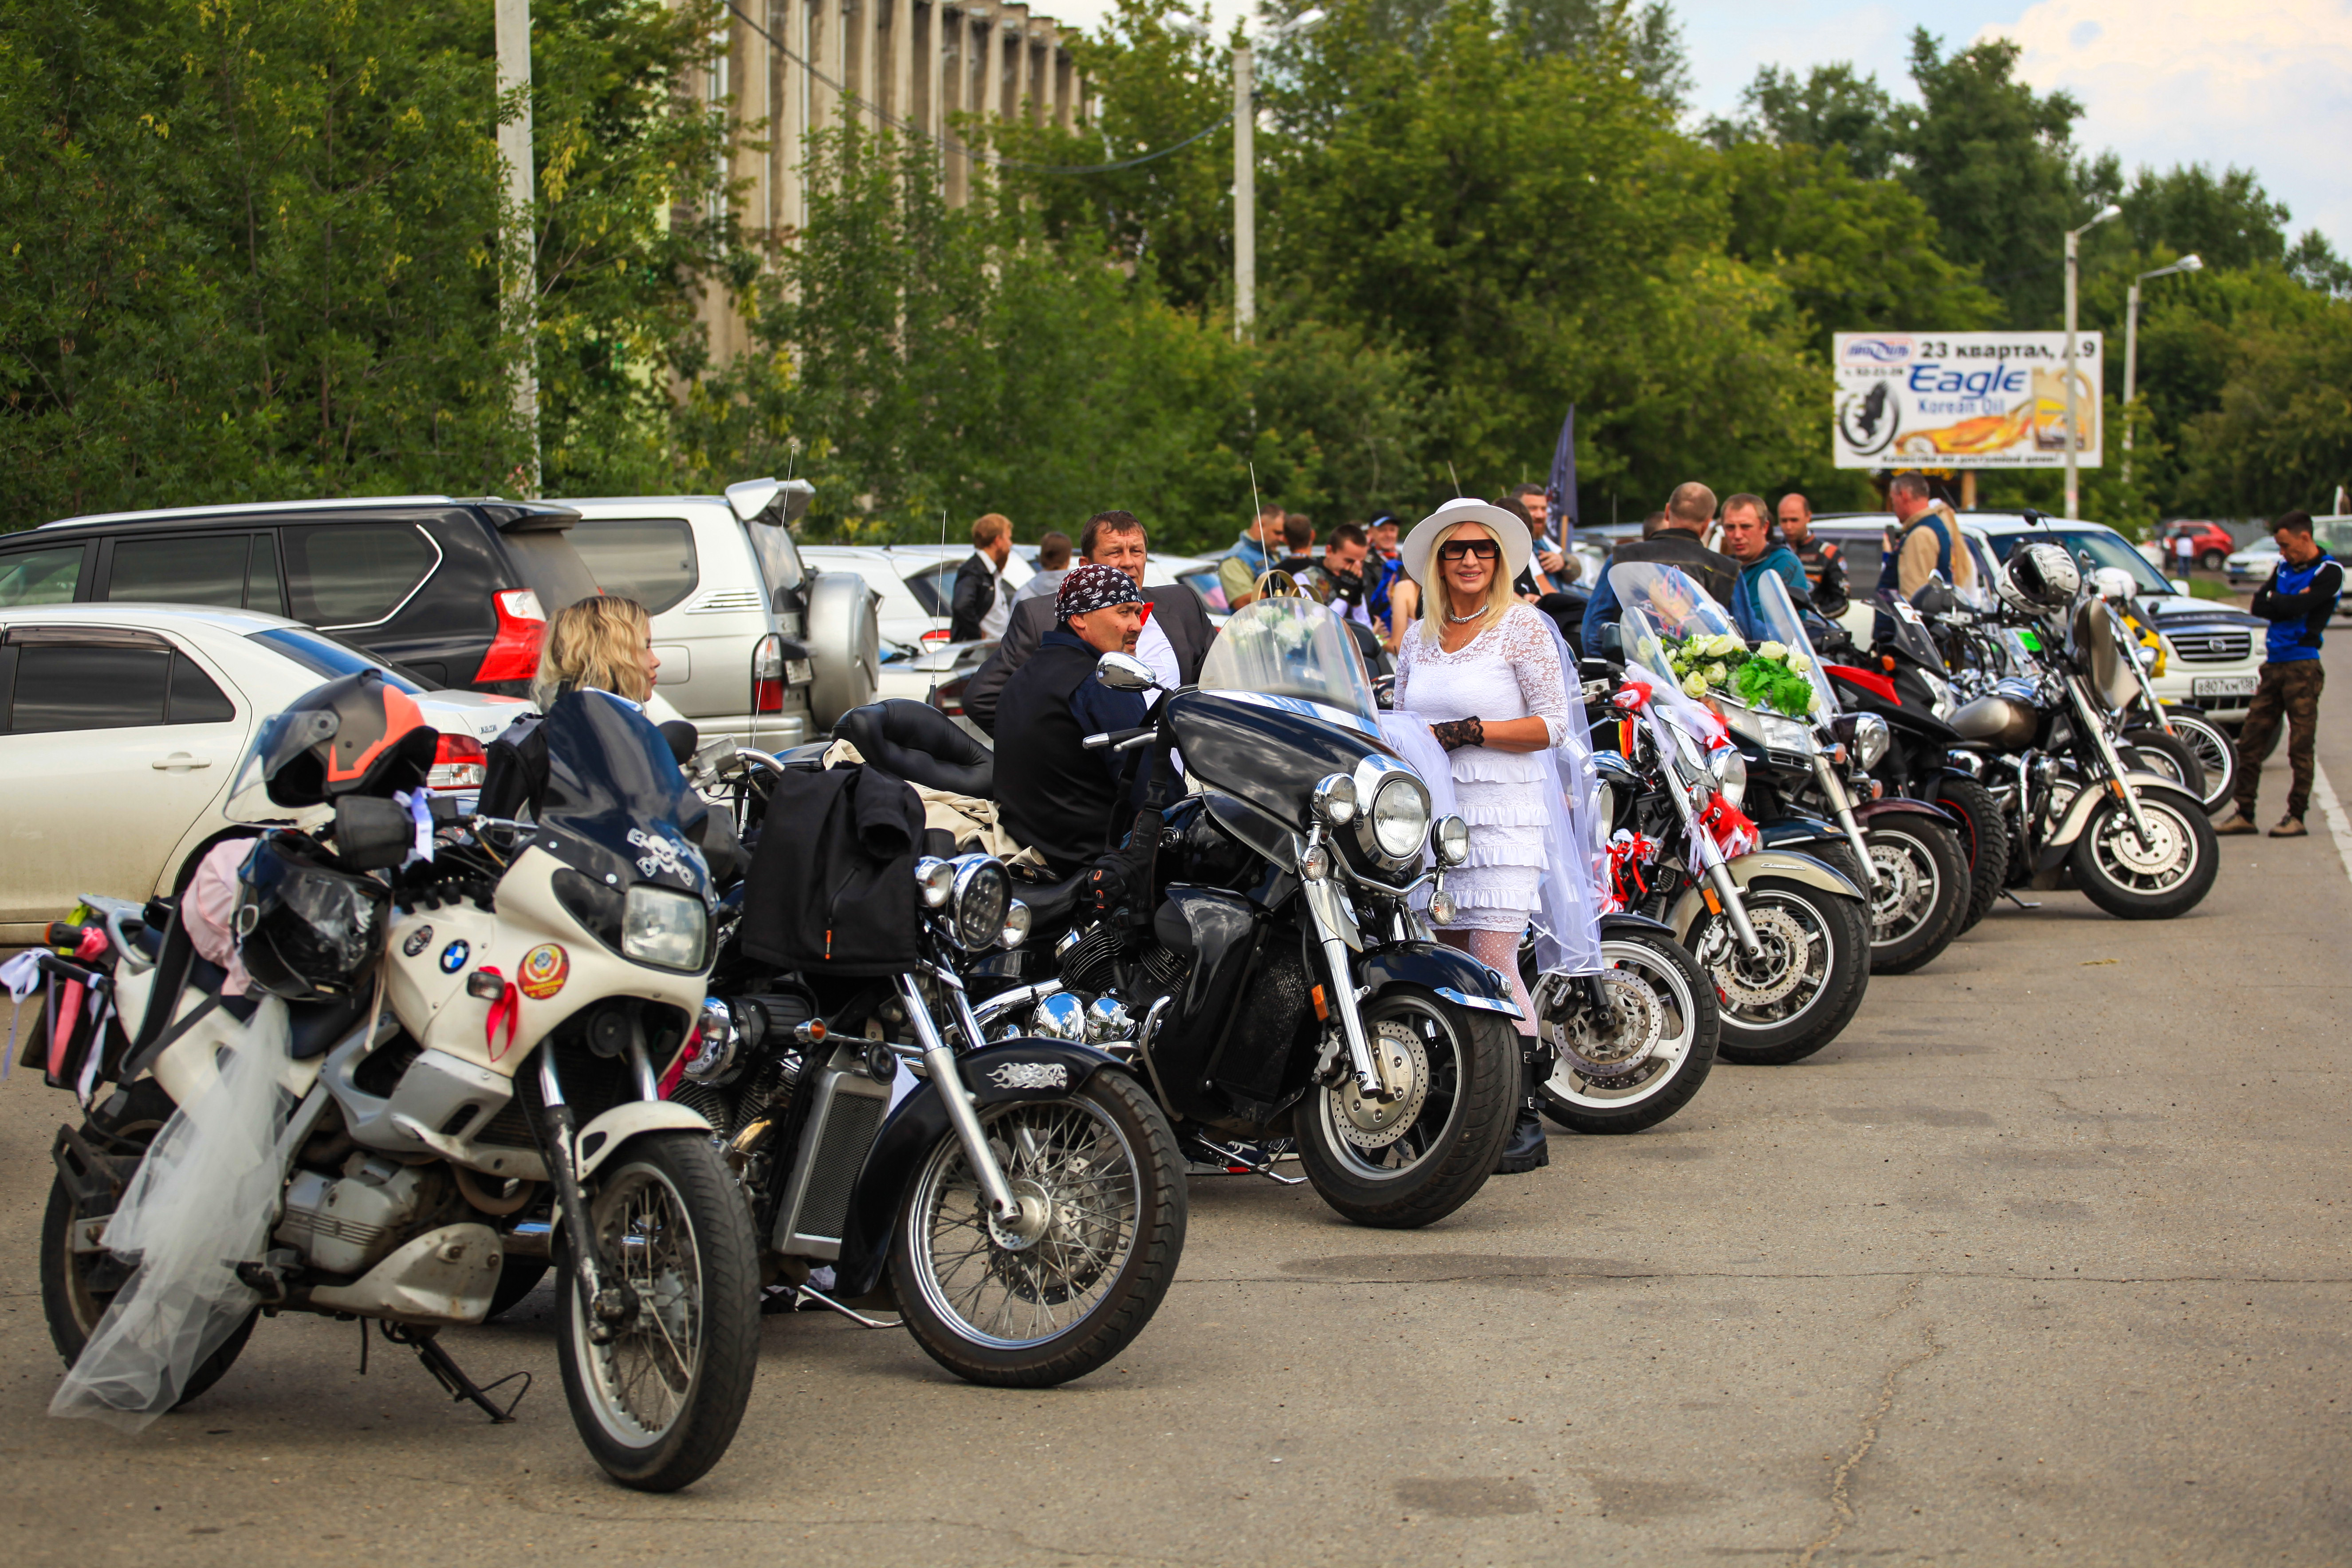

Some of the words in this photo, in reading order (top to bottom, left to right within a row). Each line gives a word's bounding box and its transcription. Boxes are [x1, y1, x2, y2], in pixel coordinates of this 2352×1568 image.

[1921, 341, 1947, 358] 23
[1956, 345, 2055, 362] квартал,
[1909, 364, 2026, 399] Eagle
[1918, 398, 1975, 415] Korean
[1982, 398, 2005, 416] Oil
[1647, 940, 1671, 957] Pilot
[1670, 959, 1692, 982] ACTIV
[1556, 985, 1568, 1001] brembo
